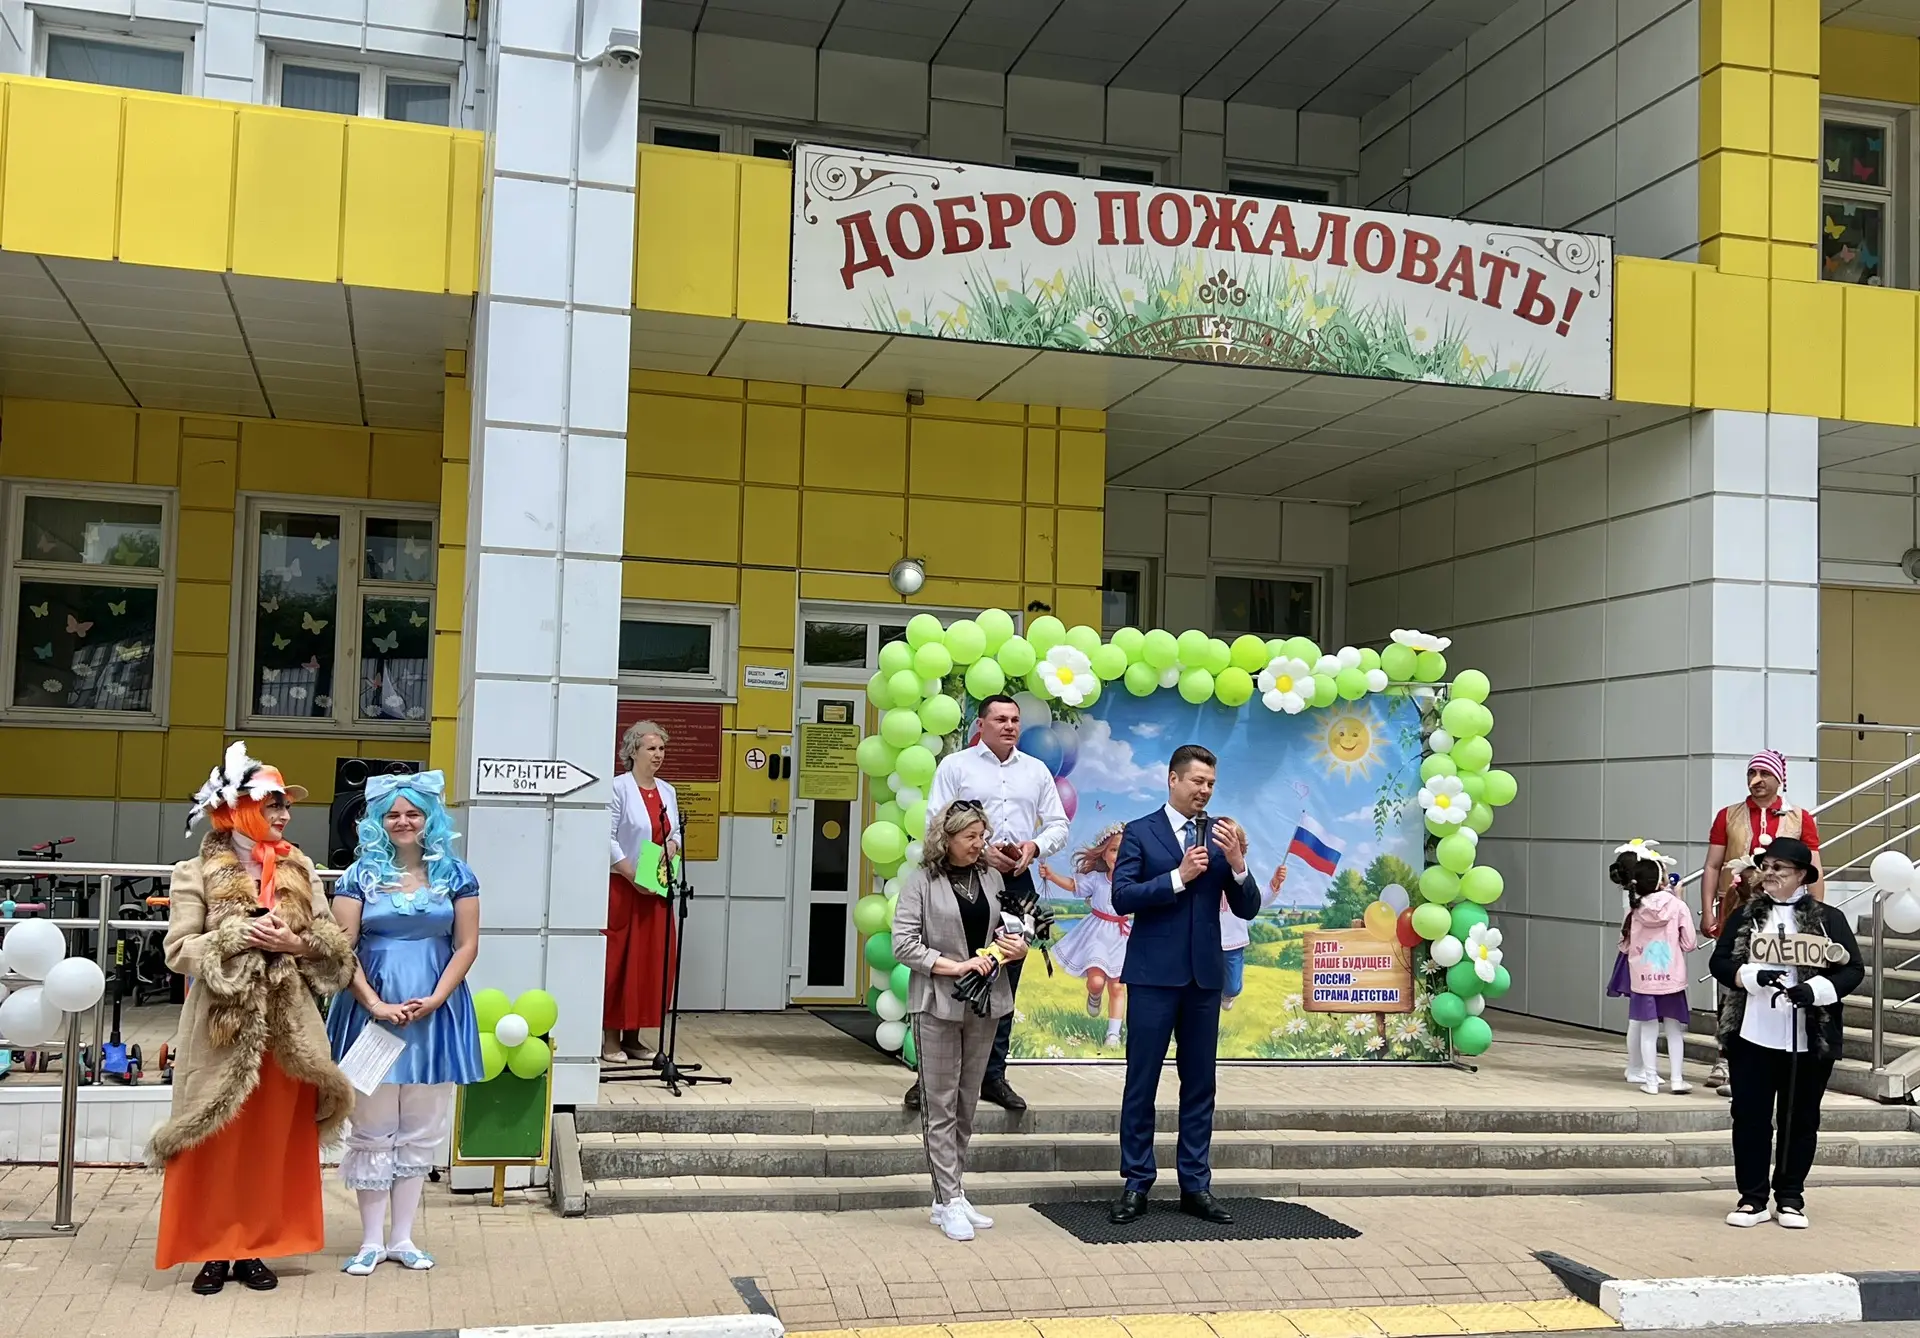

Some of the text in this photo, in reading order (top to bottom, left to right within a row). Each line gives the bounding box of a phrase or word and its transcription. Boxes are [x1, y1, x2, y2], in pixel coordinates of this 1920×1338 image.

[836, 190, 1584, 338] ДОБРО ПОЖАЛОВАТЬ!
[483, 763, 567, 780] УКРЫТИЕ
[1314, 942, 1338, 954] ДЕТИ
[1314, 956, 1391, 970] НАШЕ БУДУЩЕЕ!
[1314, 973, 1351, 985] РОССИЯ
[1314, 989, 1399, 1002] СТРАНА ДЕТСТВА!
